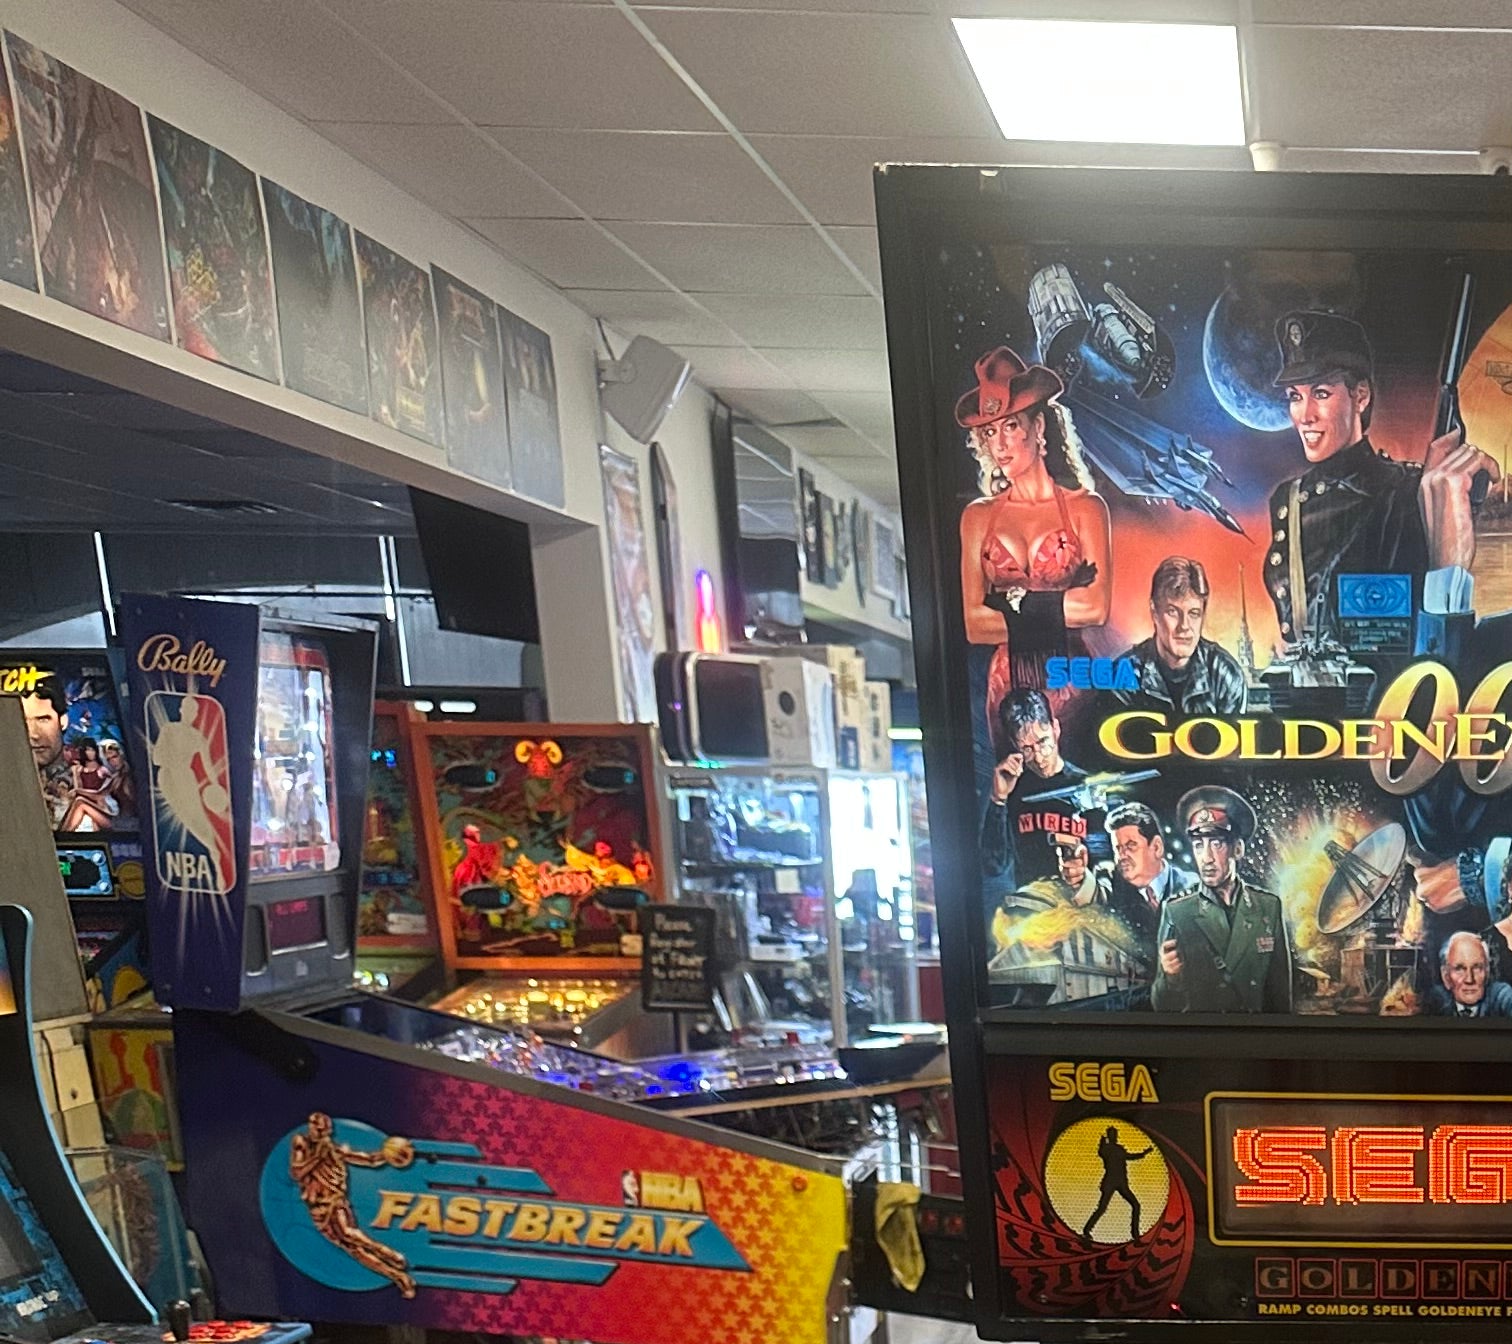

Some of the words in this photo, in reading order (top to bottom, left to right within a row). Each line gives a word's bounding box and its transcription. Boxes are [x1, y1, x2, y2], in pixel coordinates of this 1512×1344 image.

[137, 634, 227, 687] Bally
[1045, 656, 1141, 690] SEGA
[166, 851, 209, 880] NBA
[1050, 1062, 1159, 1103] SEGA
[372, 1190, 705, 1257] FASTBREAK
[1258, 1303, 1302, 1315] RAMP
[1306, 1304, 1369, 1316] COMBOS
[1373, 1304, 1414, 1316] SPELL
[1418, 1304, 1502, 1317] GOLDENEYE
